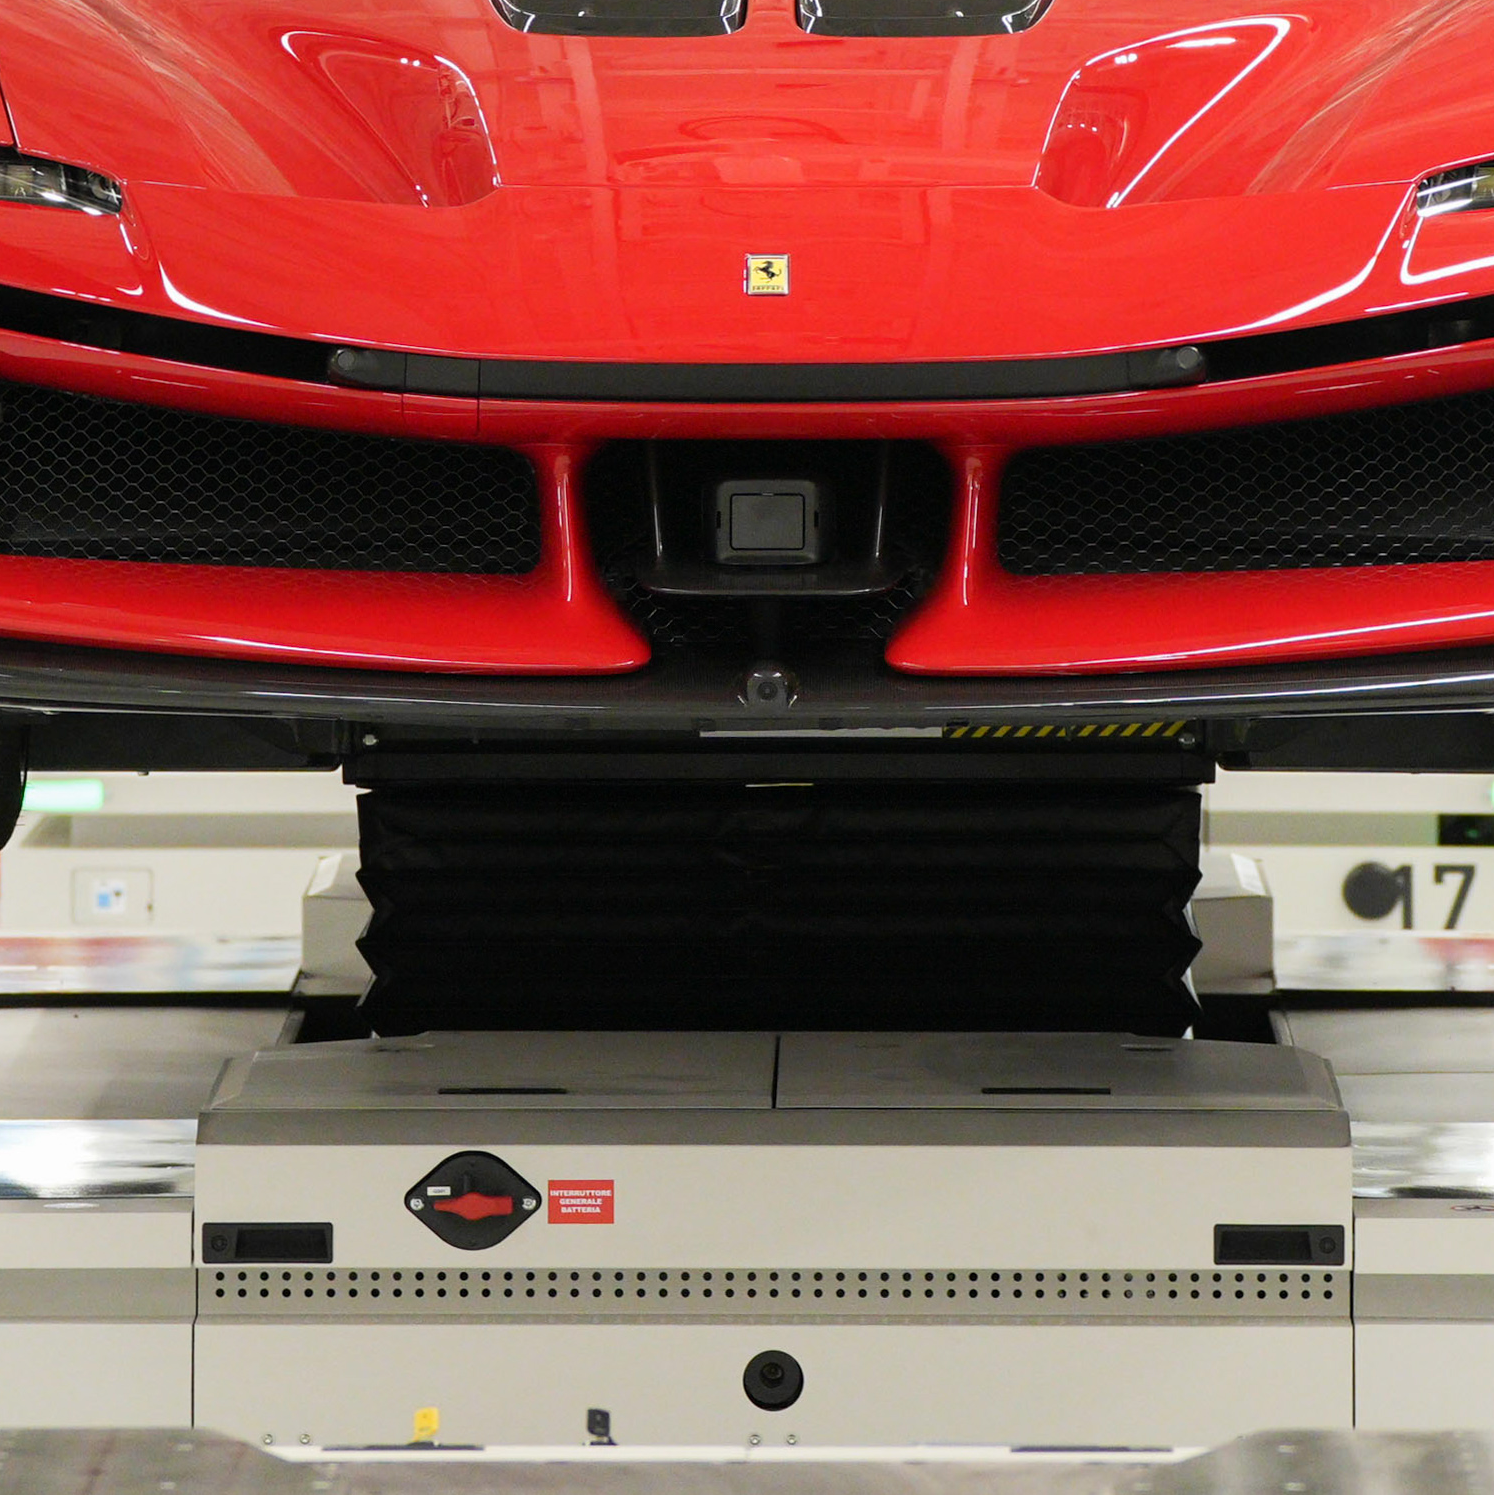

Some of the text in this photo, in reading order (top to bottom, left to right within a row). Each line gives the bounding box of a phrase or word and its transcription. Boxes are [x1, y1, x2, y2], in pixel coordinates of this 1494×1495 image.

[1394, 864, 1477, 930] 17
[550, 1189, 612, 1197] INTERRUTTORE
[559, 1197, 603, 1205] GENERALE
[560, 1206, 601, 1214] BATTERIA
